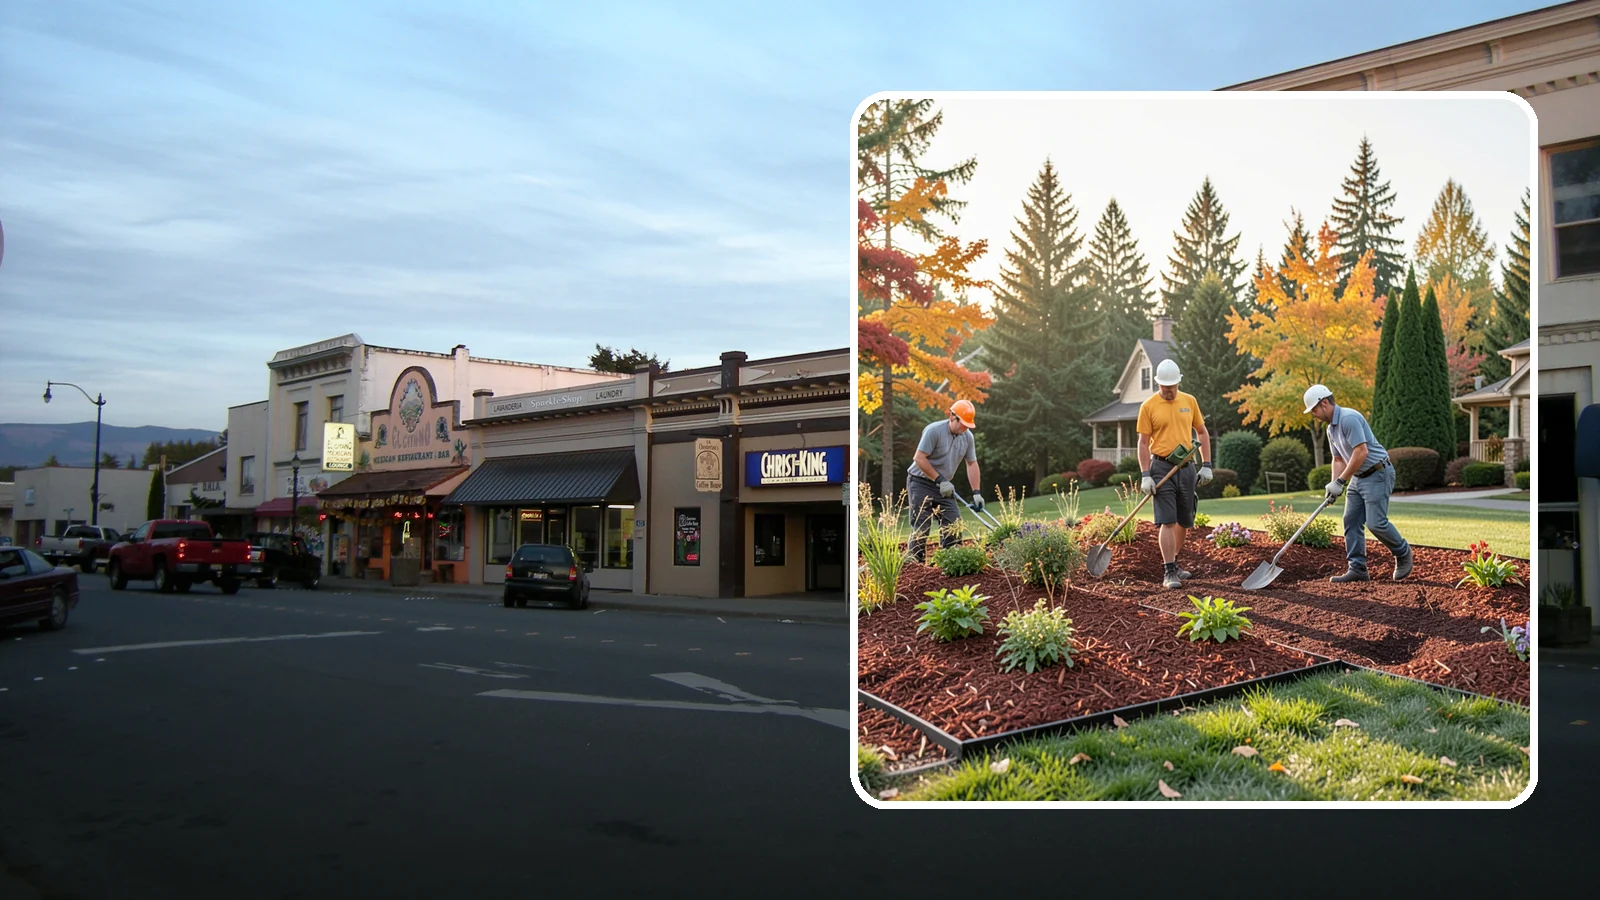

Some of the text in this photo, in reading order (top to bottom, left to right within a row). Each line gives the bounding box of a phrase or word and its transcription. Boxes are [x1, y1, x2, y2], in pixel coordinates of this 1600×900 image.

[595, 389, 623, 400] LAUNDRY
[493, 402, 522, 412] LAVANDERIA
[530, 394, 582, 408] Sparkle Shop
[373, 454, 396, 465] MEXICAN
[397, 451, 433, 463] RESTAURANT
[437, 450, 450, 459] BAR
